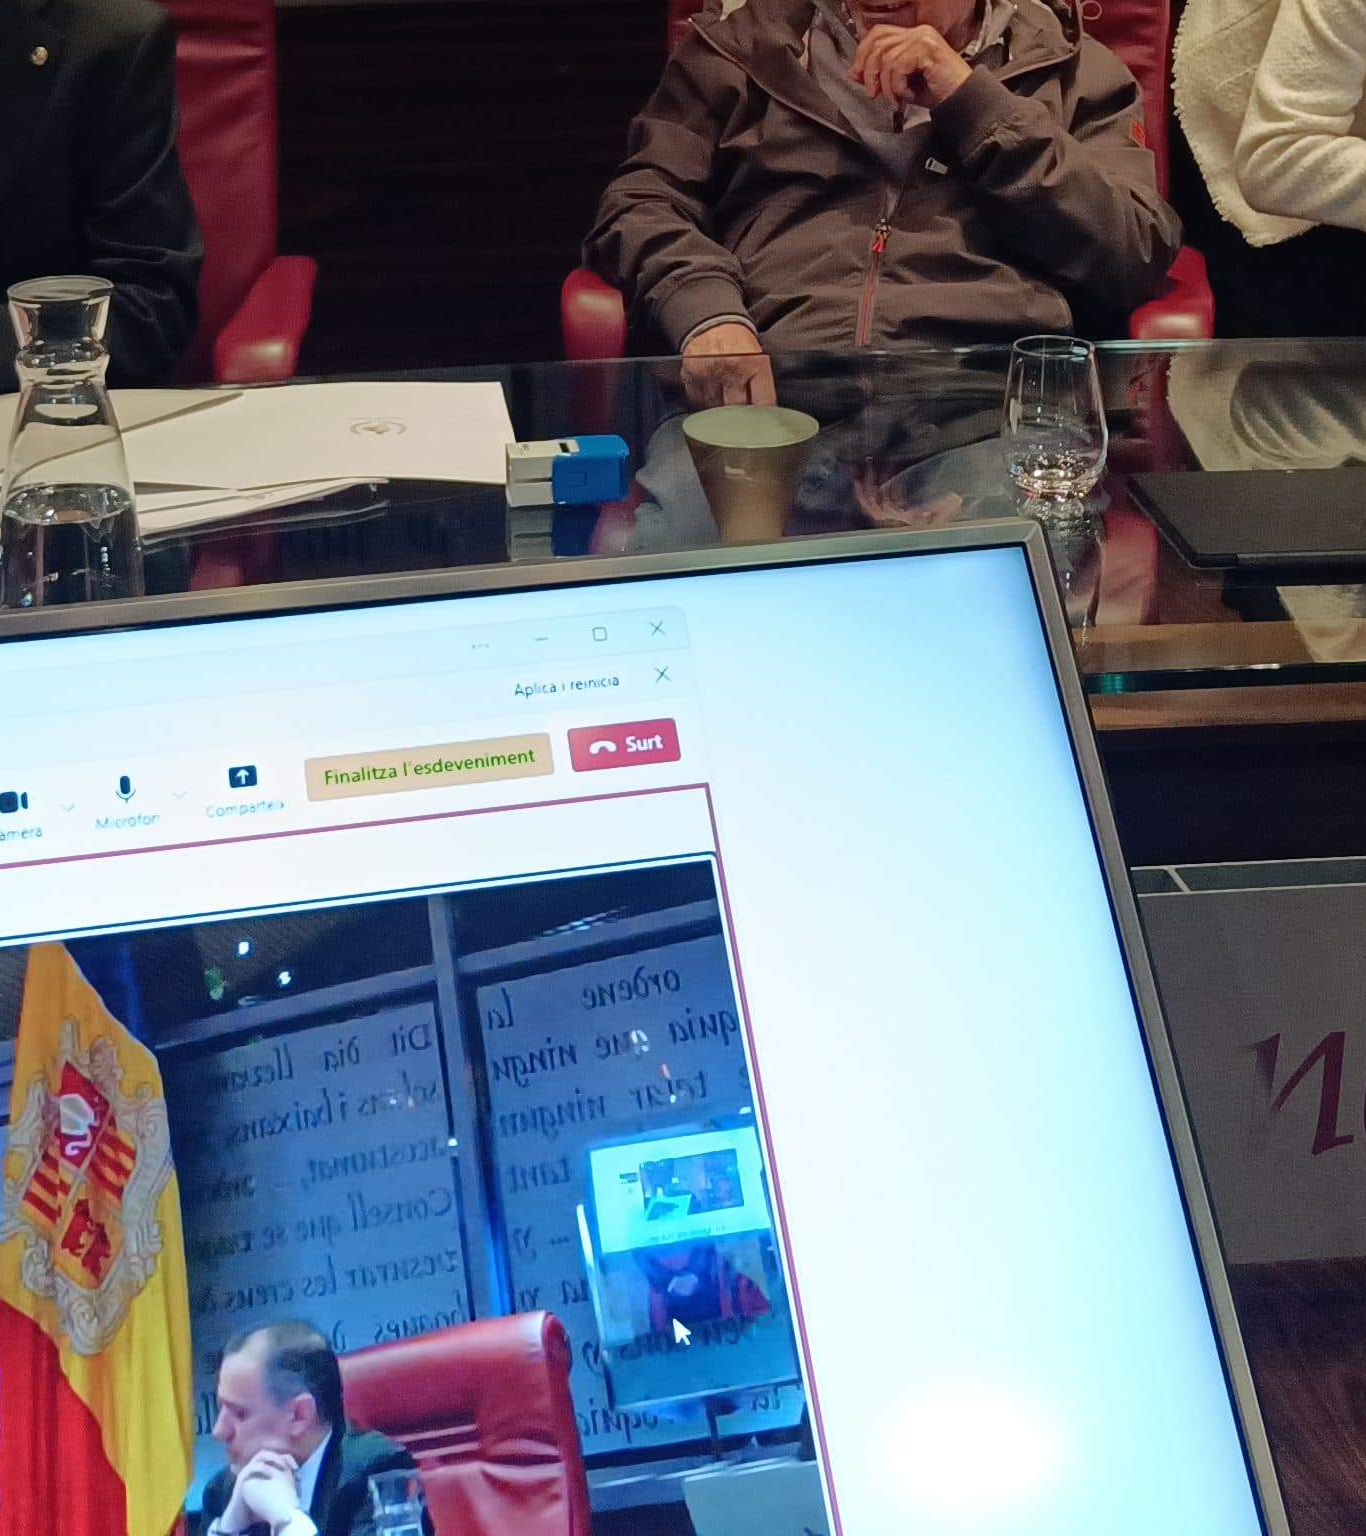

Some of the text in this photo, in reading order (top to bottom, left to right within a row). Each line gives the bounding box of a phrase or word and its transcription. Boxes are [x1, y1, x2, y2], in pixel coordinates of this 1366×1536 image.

[513, 679, 558, 699] Aplica
[569, 674, 621, 692] reinicia
[625, 732, 665, 755] Surt
[323, 747, 537, 787] Finalitza l'esdeveniment
